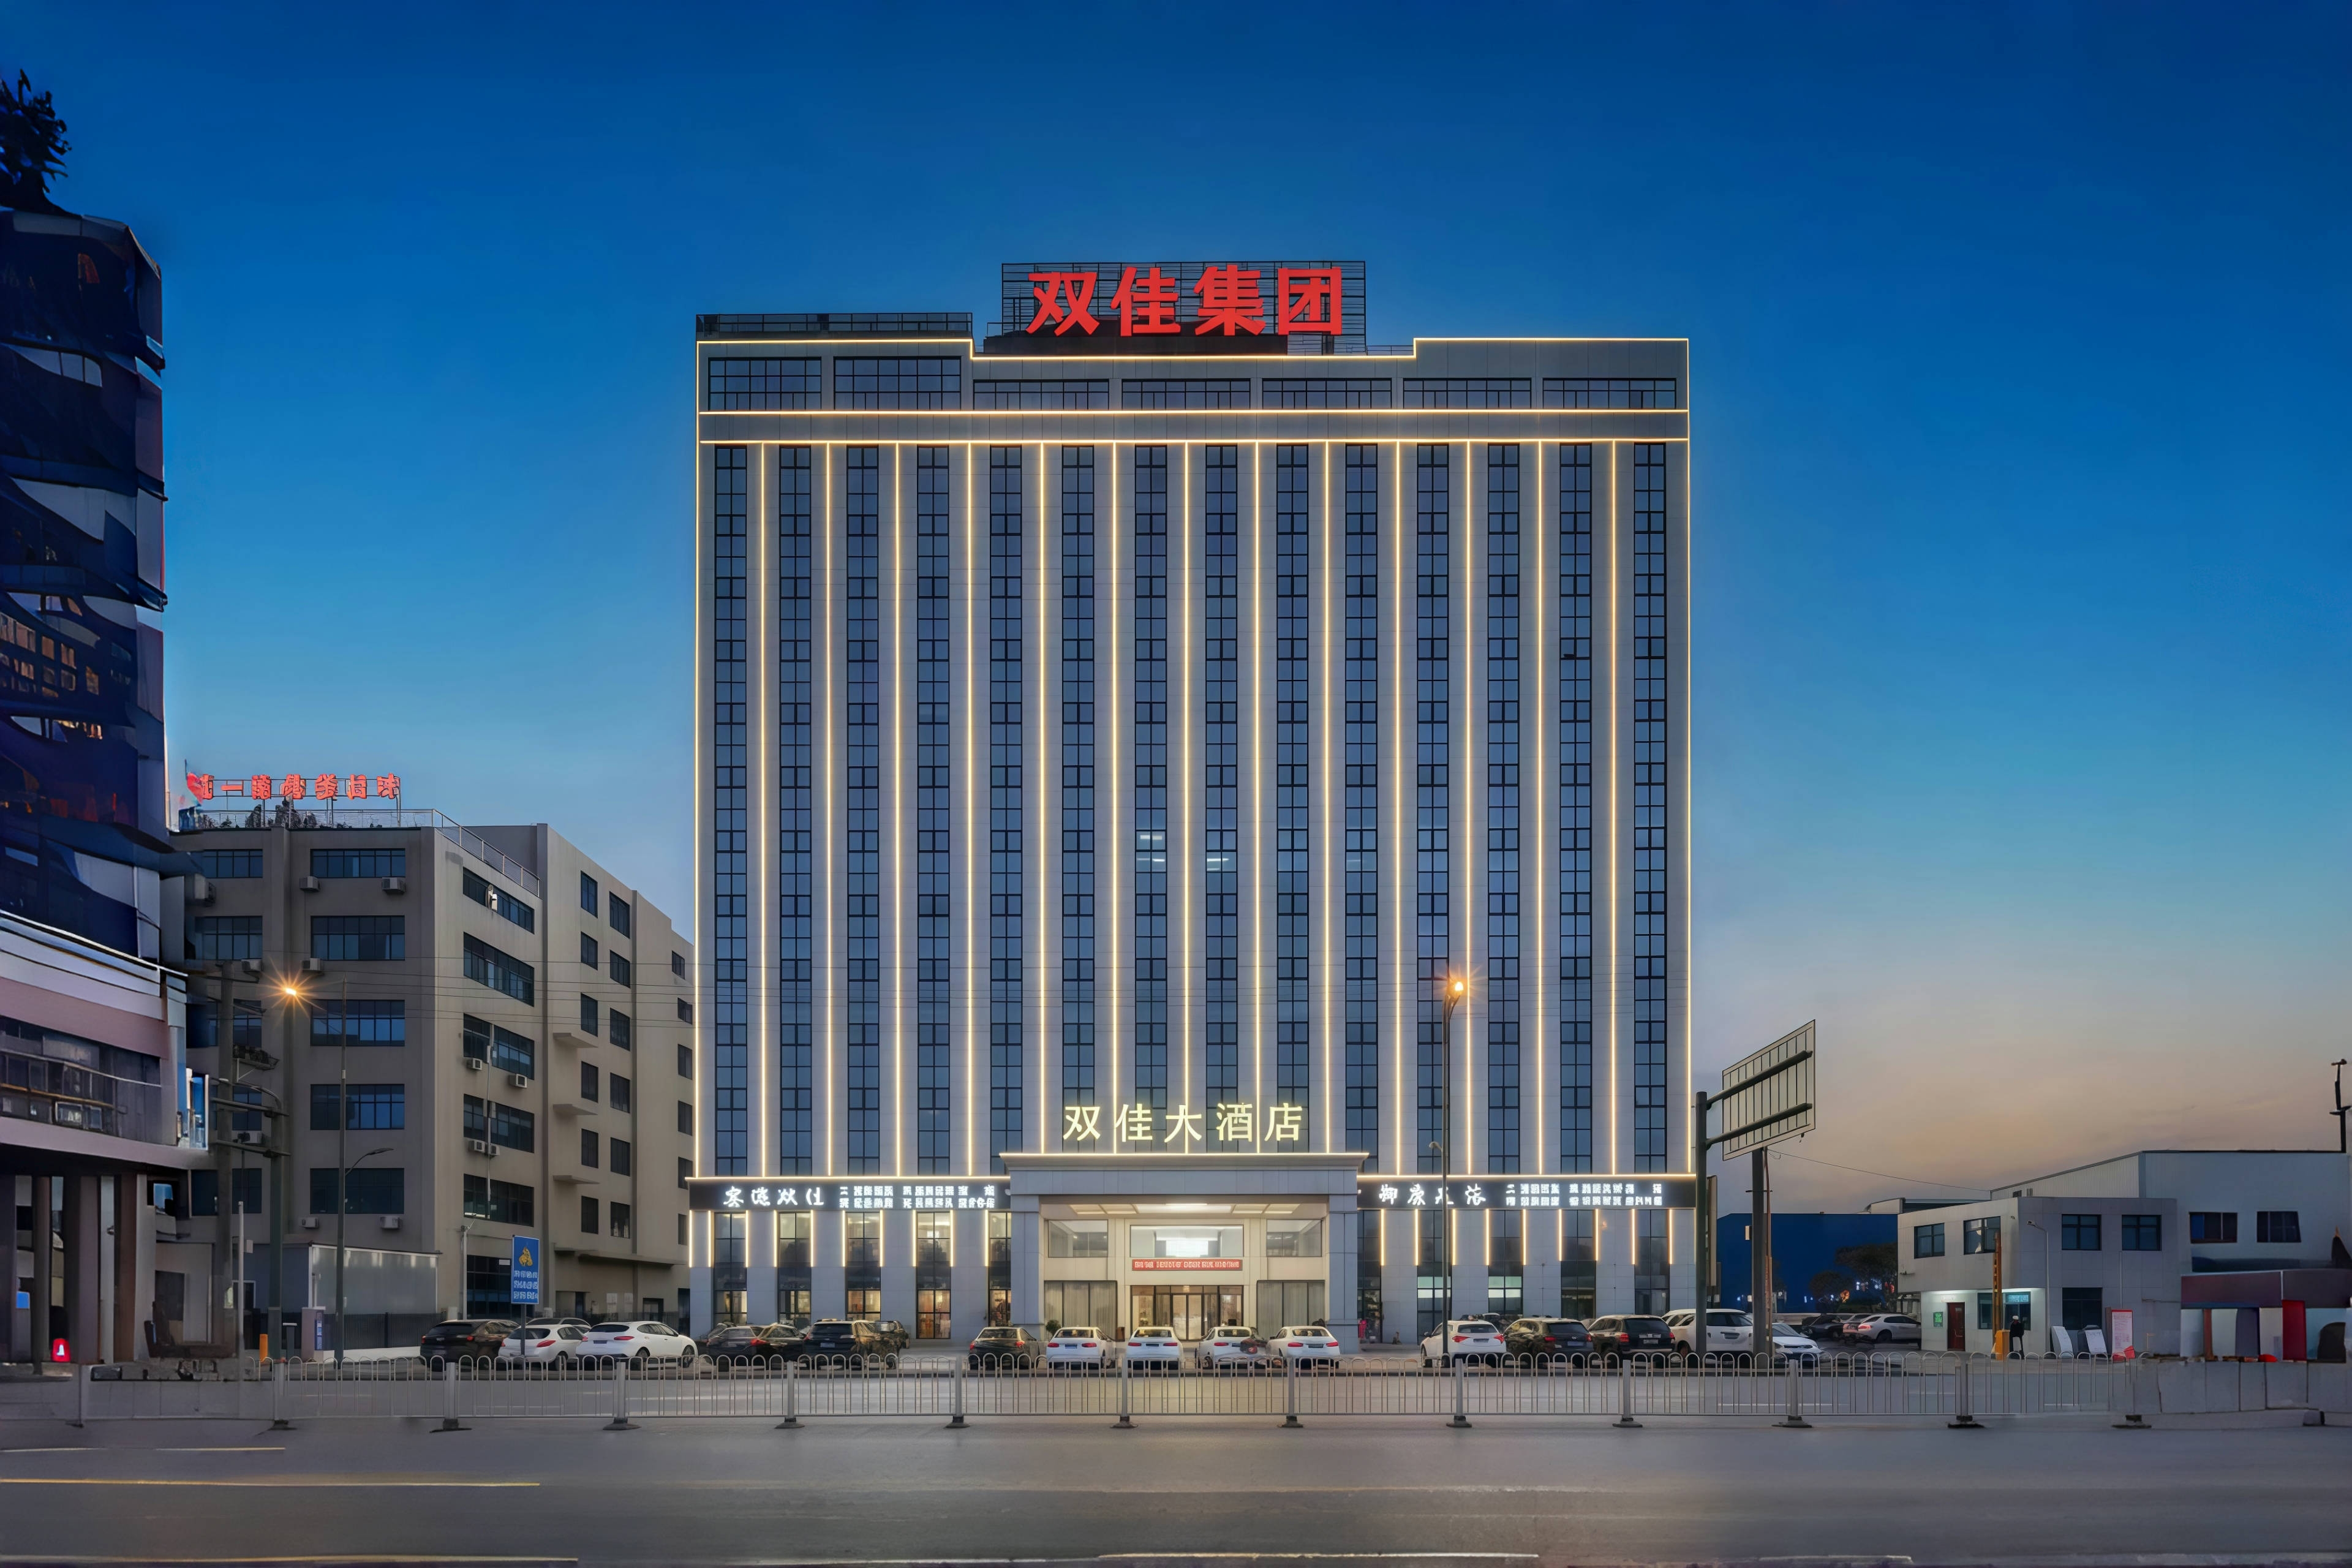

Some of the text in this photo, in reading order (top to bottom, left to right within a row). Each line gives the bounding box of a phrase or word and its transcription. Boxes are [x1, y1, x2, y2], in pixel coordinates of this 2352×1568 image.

[1026, 265, 1342, 336] 双佳集团
[1063, 1102, 1303, 1143] 双佳大酒店
